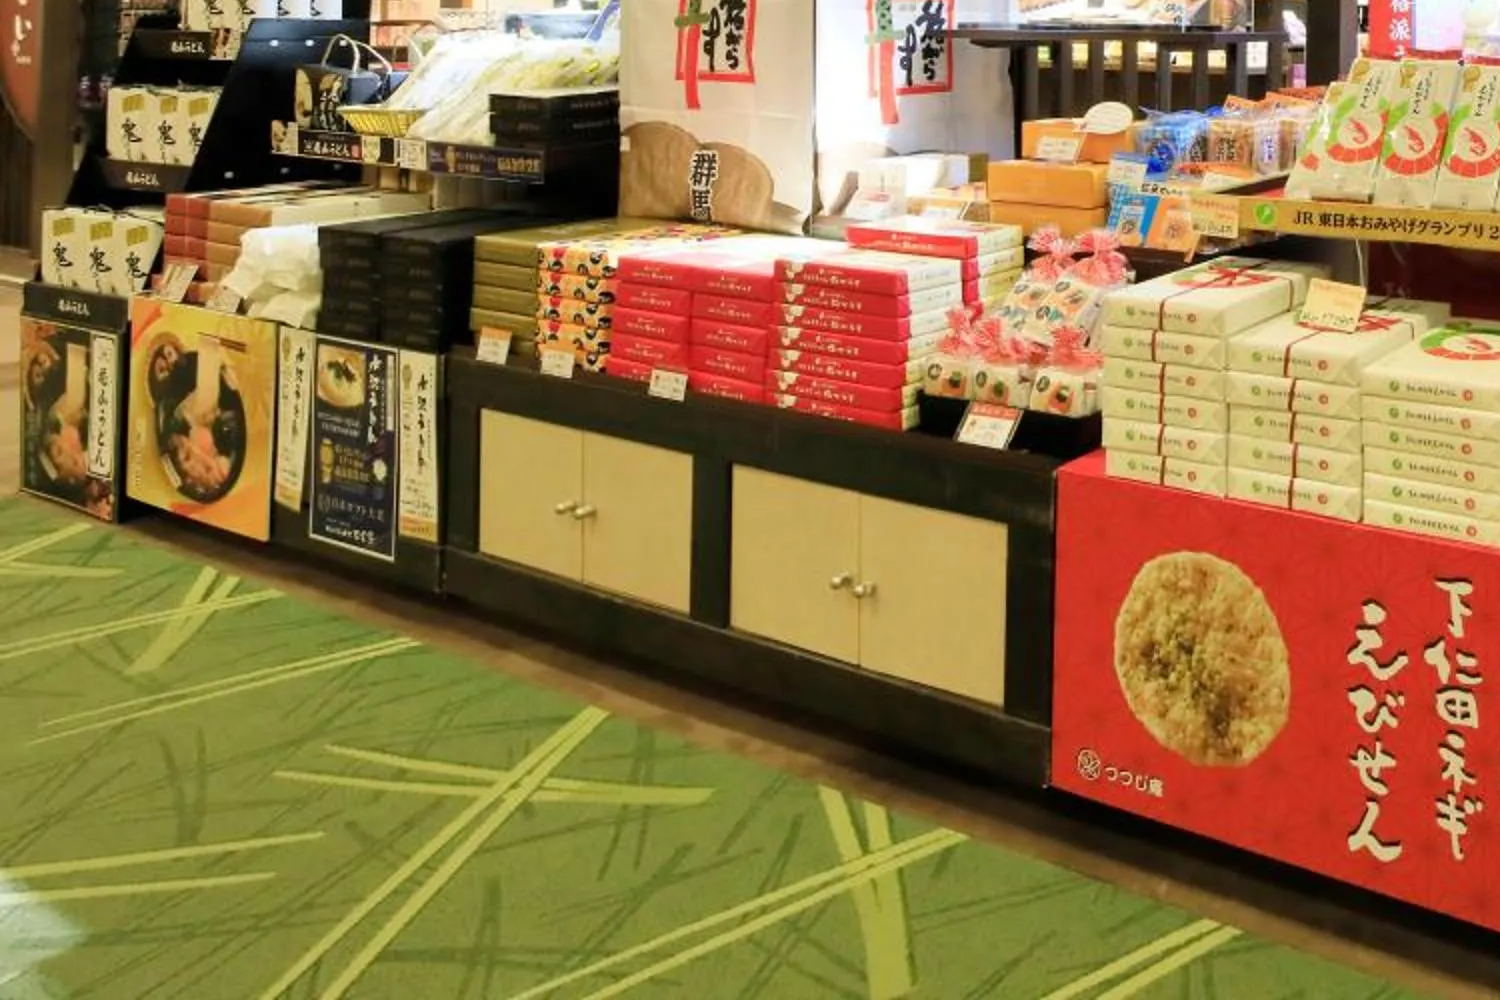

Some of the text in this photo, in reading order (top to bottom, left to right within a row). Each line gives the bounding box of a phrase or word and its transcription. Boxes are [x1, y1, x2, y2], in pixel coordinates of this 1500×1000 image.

[1347, 599, 1409, 863] えびせん
[1424, 577, 1483, 860] 下仁田ネギ
